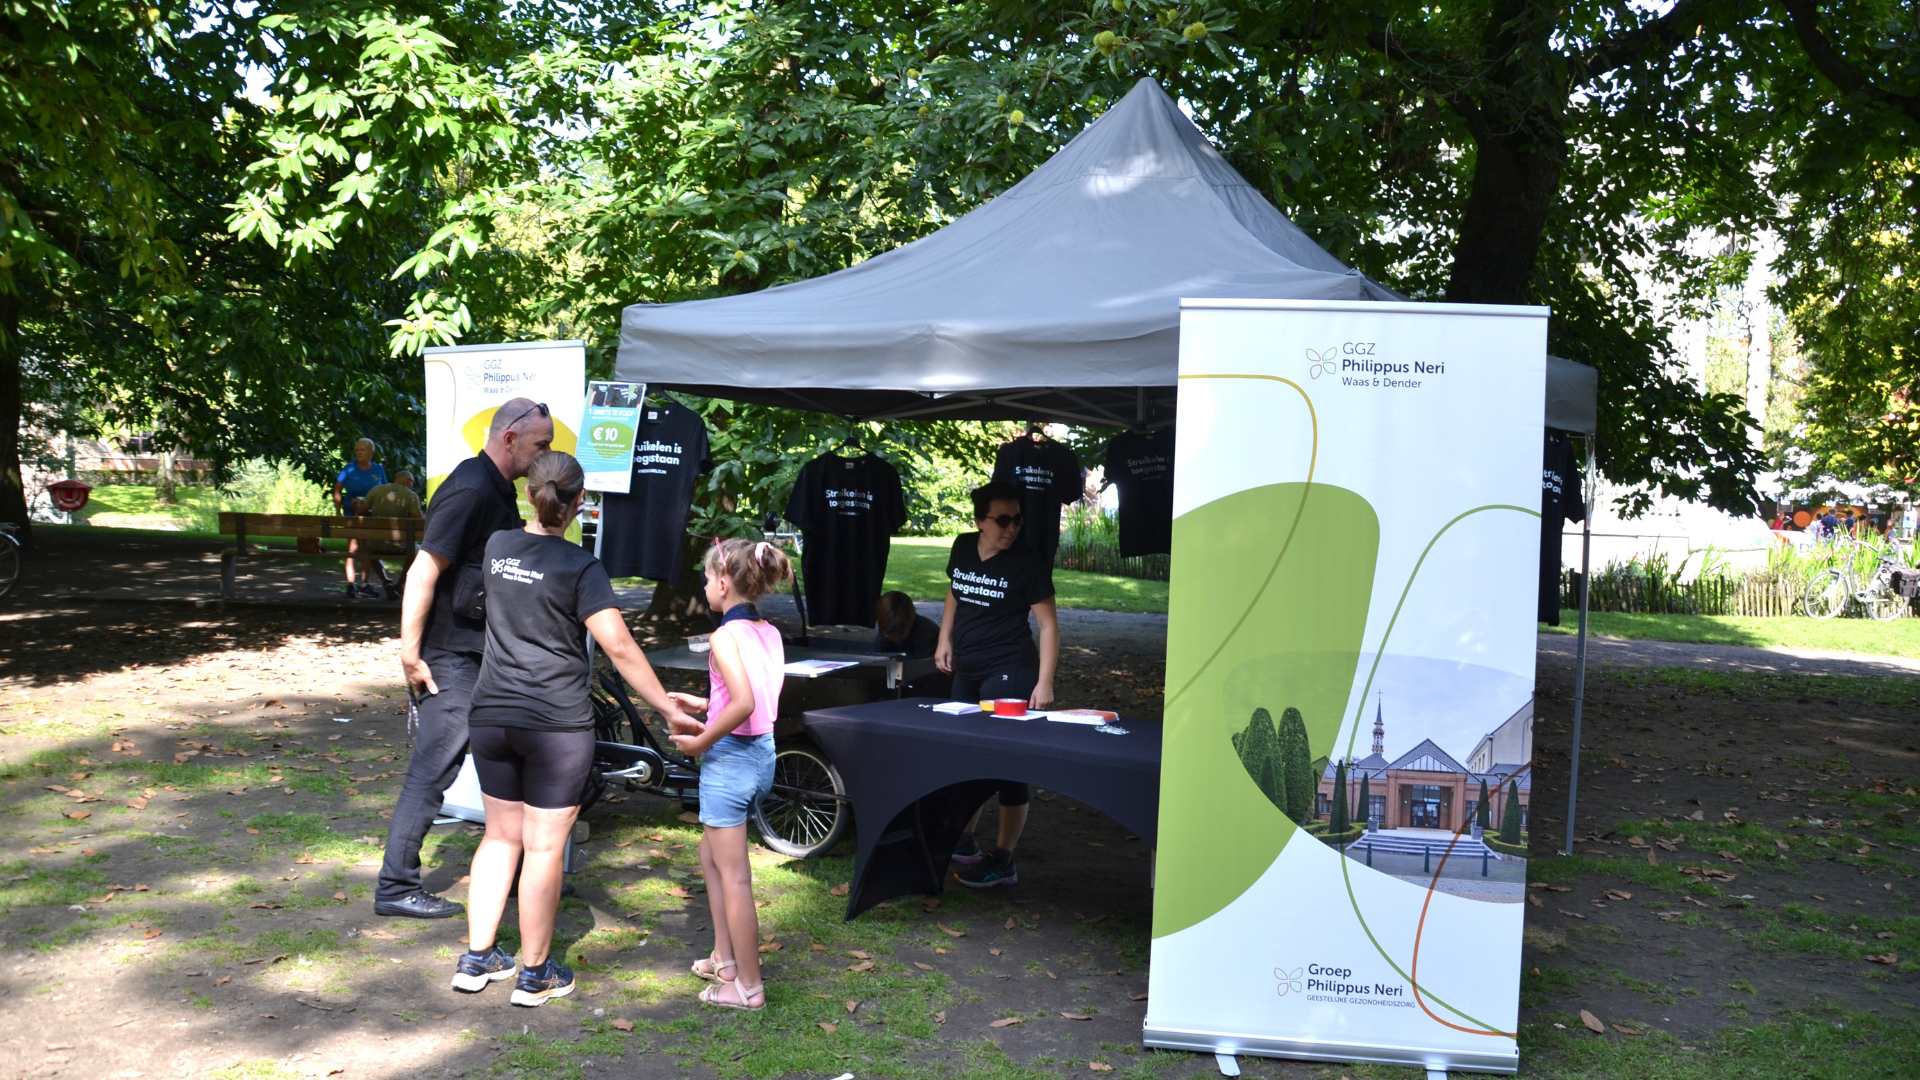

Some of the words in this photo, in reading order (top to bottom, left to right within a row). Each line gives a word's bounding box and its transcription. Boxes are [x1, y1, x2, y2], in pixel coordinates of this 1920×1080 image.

[1342, 342, 1376, 355] GGZ
[1342, 359, 1410, 375] Philippus
[1414, 361, 1445, 374] Neri
[1342, 377, 1370, 387] Waas
[1372, 378, 1380, 387] &
[1383, 378, 1422, 388] Dender
[605, 427, 618, 441] 10
[673, 442, 682, 454] is
[999, 577, 1008, 588] is
[1308, 963, 1352, 979] Groep
[1307, 978, 1370, 995] Philippus
[1374, 984, 1403, 997] Neri
[1306, 994, 1347, 1004] GEESTELIJKE
[1349, 997, 1415, 1008] GEZONDHEIDSZORG
